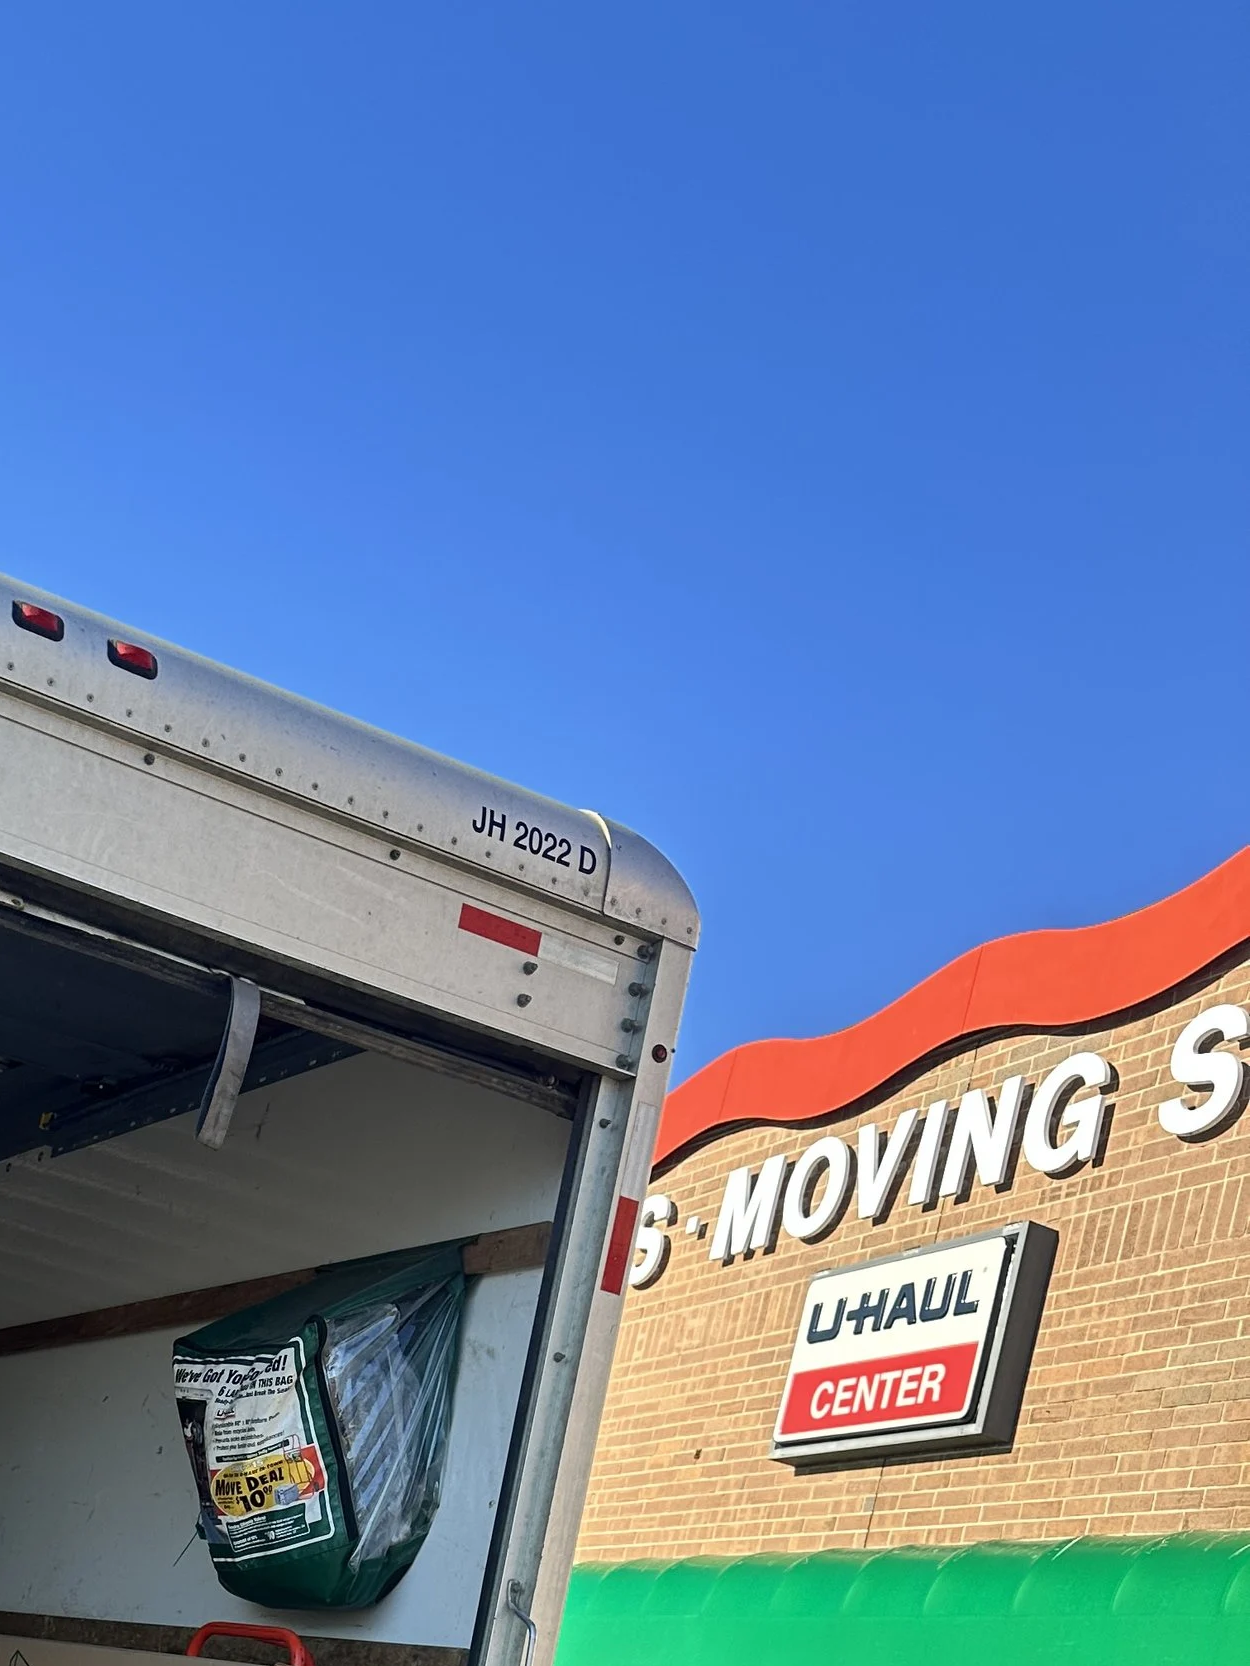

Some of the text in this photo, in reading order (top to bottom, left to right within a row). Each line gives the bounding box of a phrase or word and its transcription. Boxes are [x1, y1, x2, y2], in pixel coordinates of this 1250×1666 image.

[472, 806, 597, 875] JH 2022 D
[708, 1051, 1111, 1262] MOVING
[806, 1268, 980, 1345] U-HAUL
[202, 1368, 225, 1384] Got
[258, 1377, 272, 1388] THIS
[275, 1375, 293, 1386] BAG
[810, 1362, 946, 1419] CENTER
